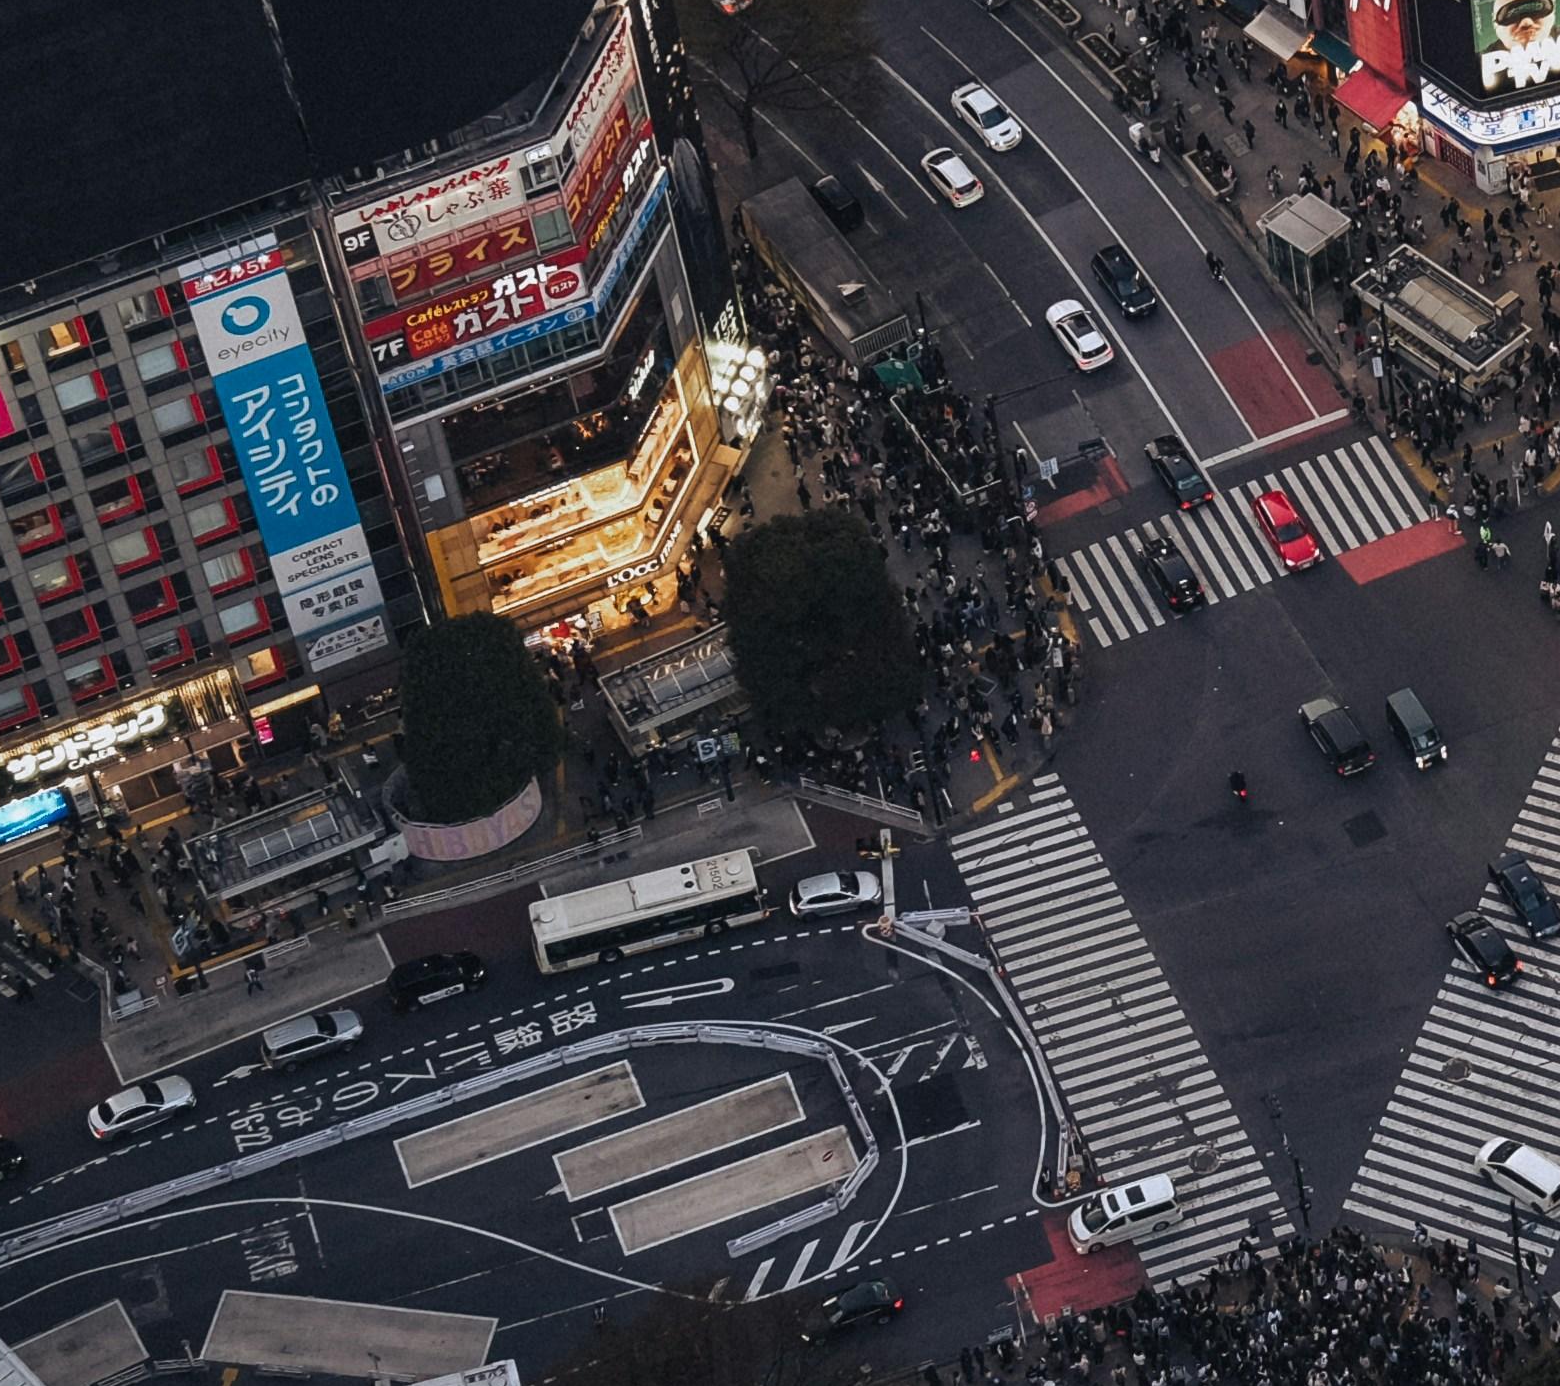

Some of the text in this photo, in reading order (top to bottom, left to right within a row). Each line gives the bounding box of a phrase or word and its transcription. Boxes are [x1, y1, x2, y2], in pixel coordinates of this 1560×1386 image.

[425, 177, 512, 223] しゃぶ葉
[343, 231, 372, 253] 9F
[390, 224, 528, 291] プライス
[492, 263, 558, 299] ガスト
[453, 294, 534, 340] ガスト
[217, 325, 291, 362] eyecity
[372, 337, 405, 363] 7F
[231, 385, 301, 517] アイシティ
[277, 372, 340, 508] コンタクトの
[287, 551, 360, 584] SPECIALISTS
[292, 537, 345, 564] CONTACT
[306, 551, 335, 569] LENS
[6, 705, 167, 781] サンドラッグ
